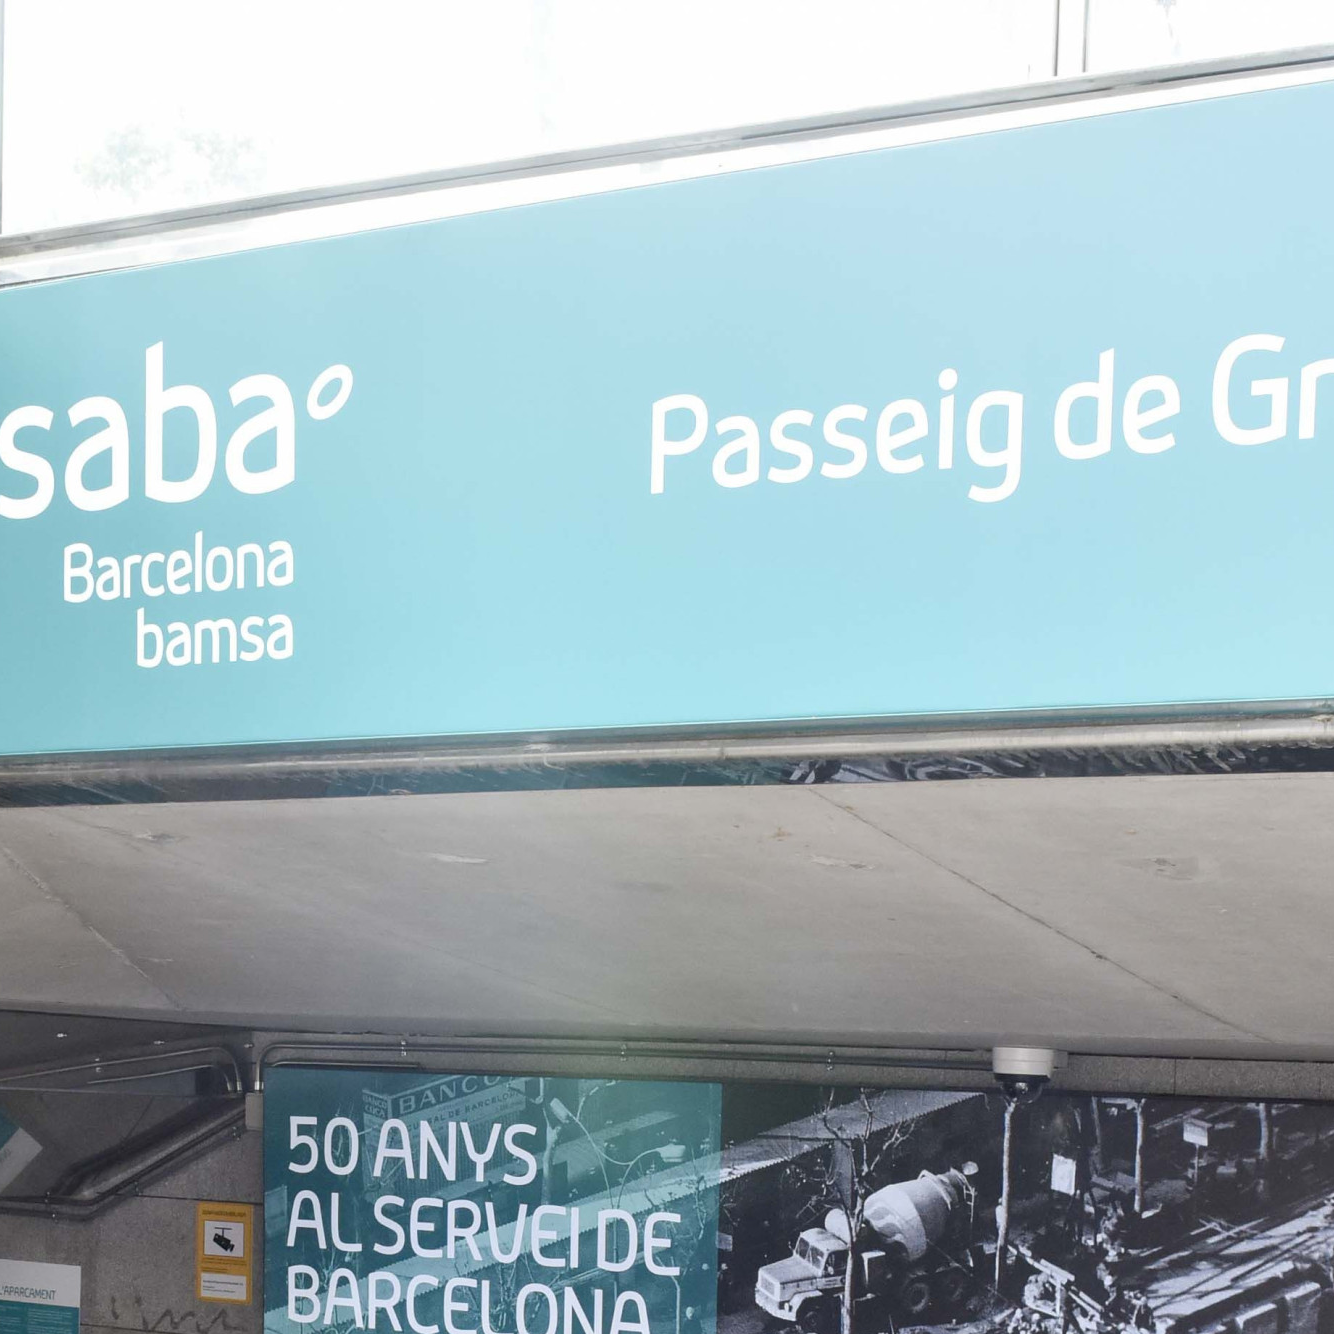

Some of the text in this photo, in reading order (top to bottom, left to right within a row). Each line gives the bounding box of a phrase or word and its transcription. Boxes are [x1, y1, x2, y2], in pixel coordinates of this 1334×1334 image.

[650, 368, 1023, 503] Passeig
[1054, 347, 1181, 461] de
[64, 531, 294, 603] Barcelona
[137, 609, 294, 668] bamsa
[288, 1116, 538, 1185] 50 ANYS
[286, 1190, 681, 1276] AL SERVEI DE
